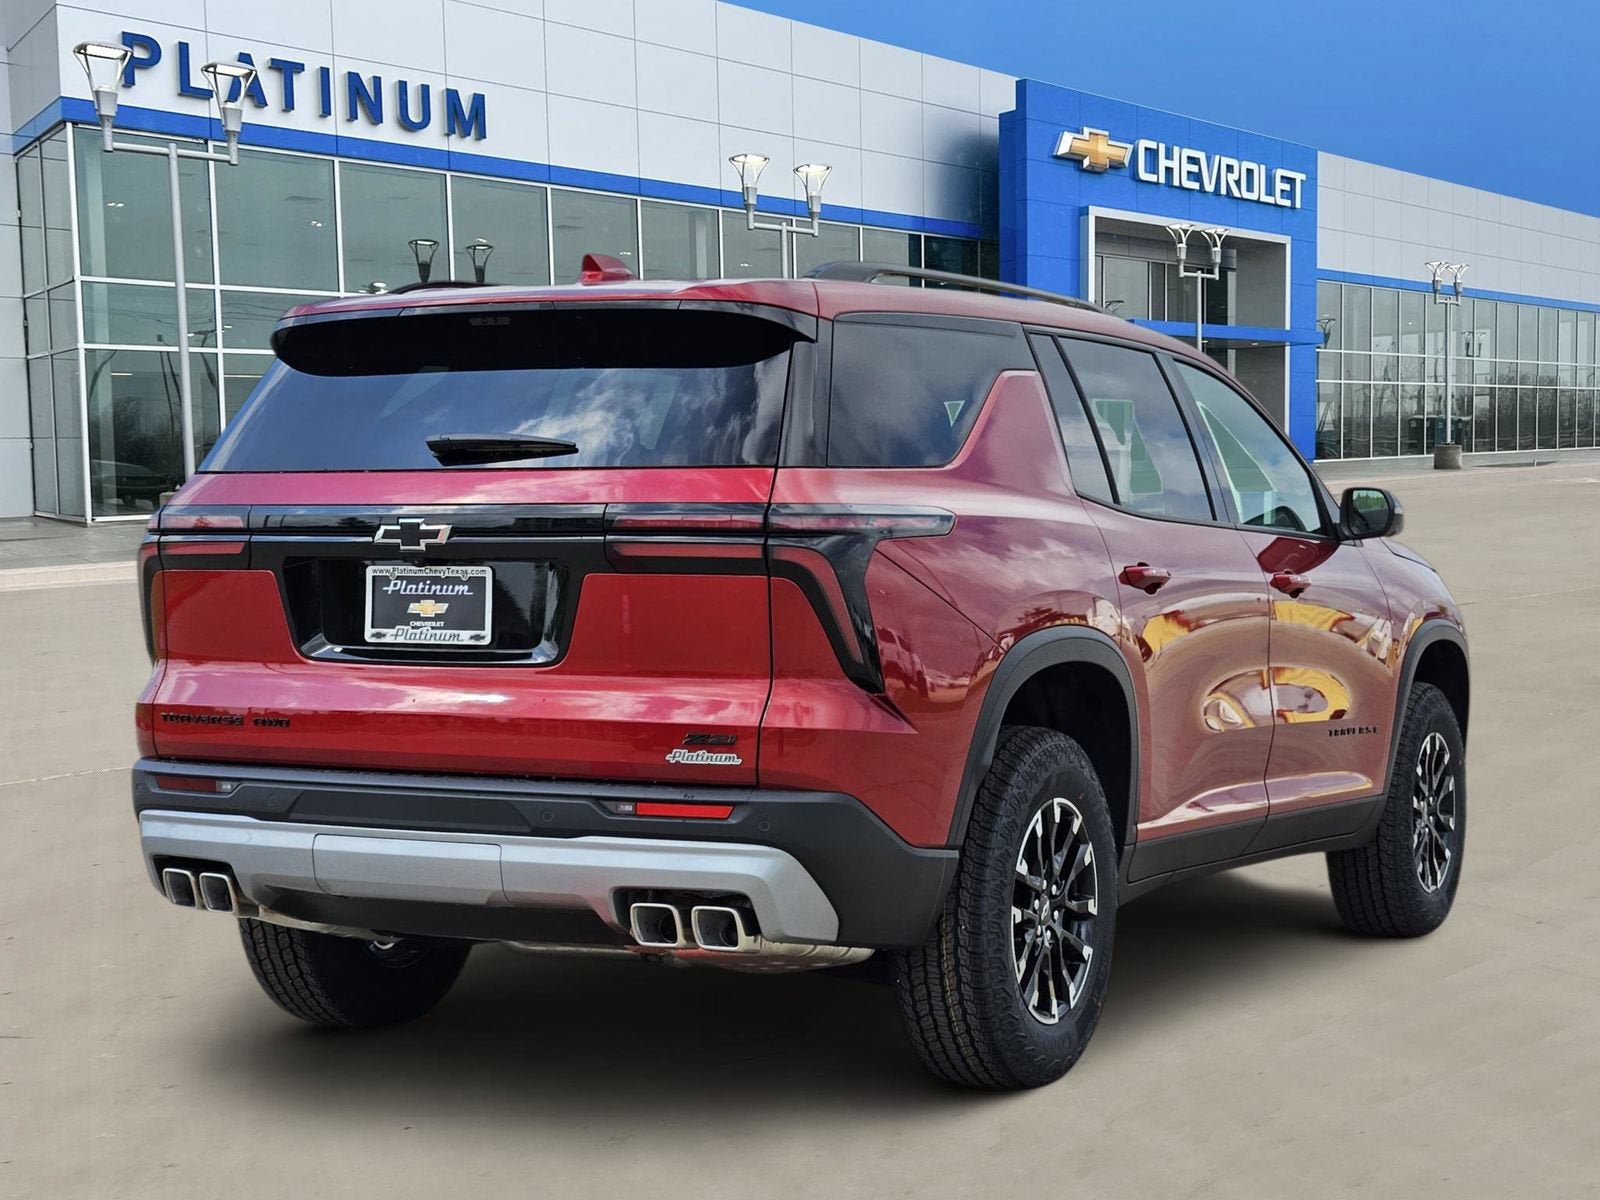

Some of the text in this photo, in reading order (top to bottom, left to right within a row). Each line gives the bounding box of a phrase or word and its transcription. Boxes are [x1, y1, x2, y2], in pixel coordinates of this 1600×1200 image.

[121, 31, 486, 140] PLATINUM
[1136, 139, 1306, 208] CHEVROLET
[371, 567, 487, 577] www.PlatinumChevyTexas.com
[382, 580, 474, 595] Platinum
[390, 628, 466, 641] Platinum
[160, 712, 290, 728] TRAVERSE AWD
[665, 749, 742, 764] Platinum
